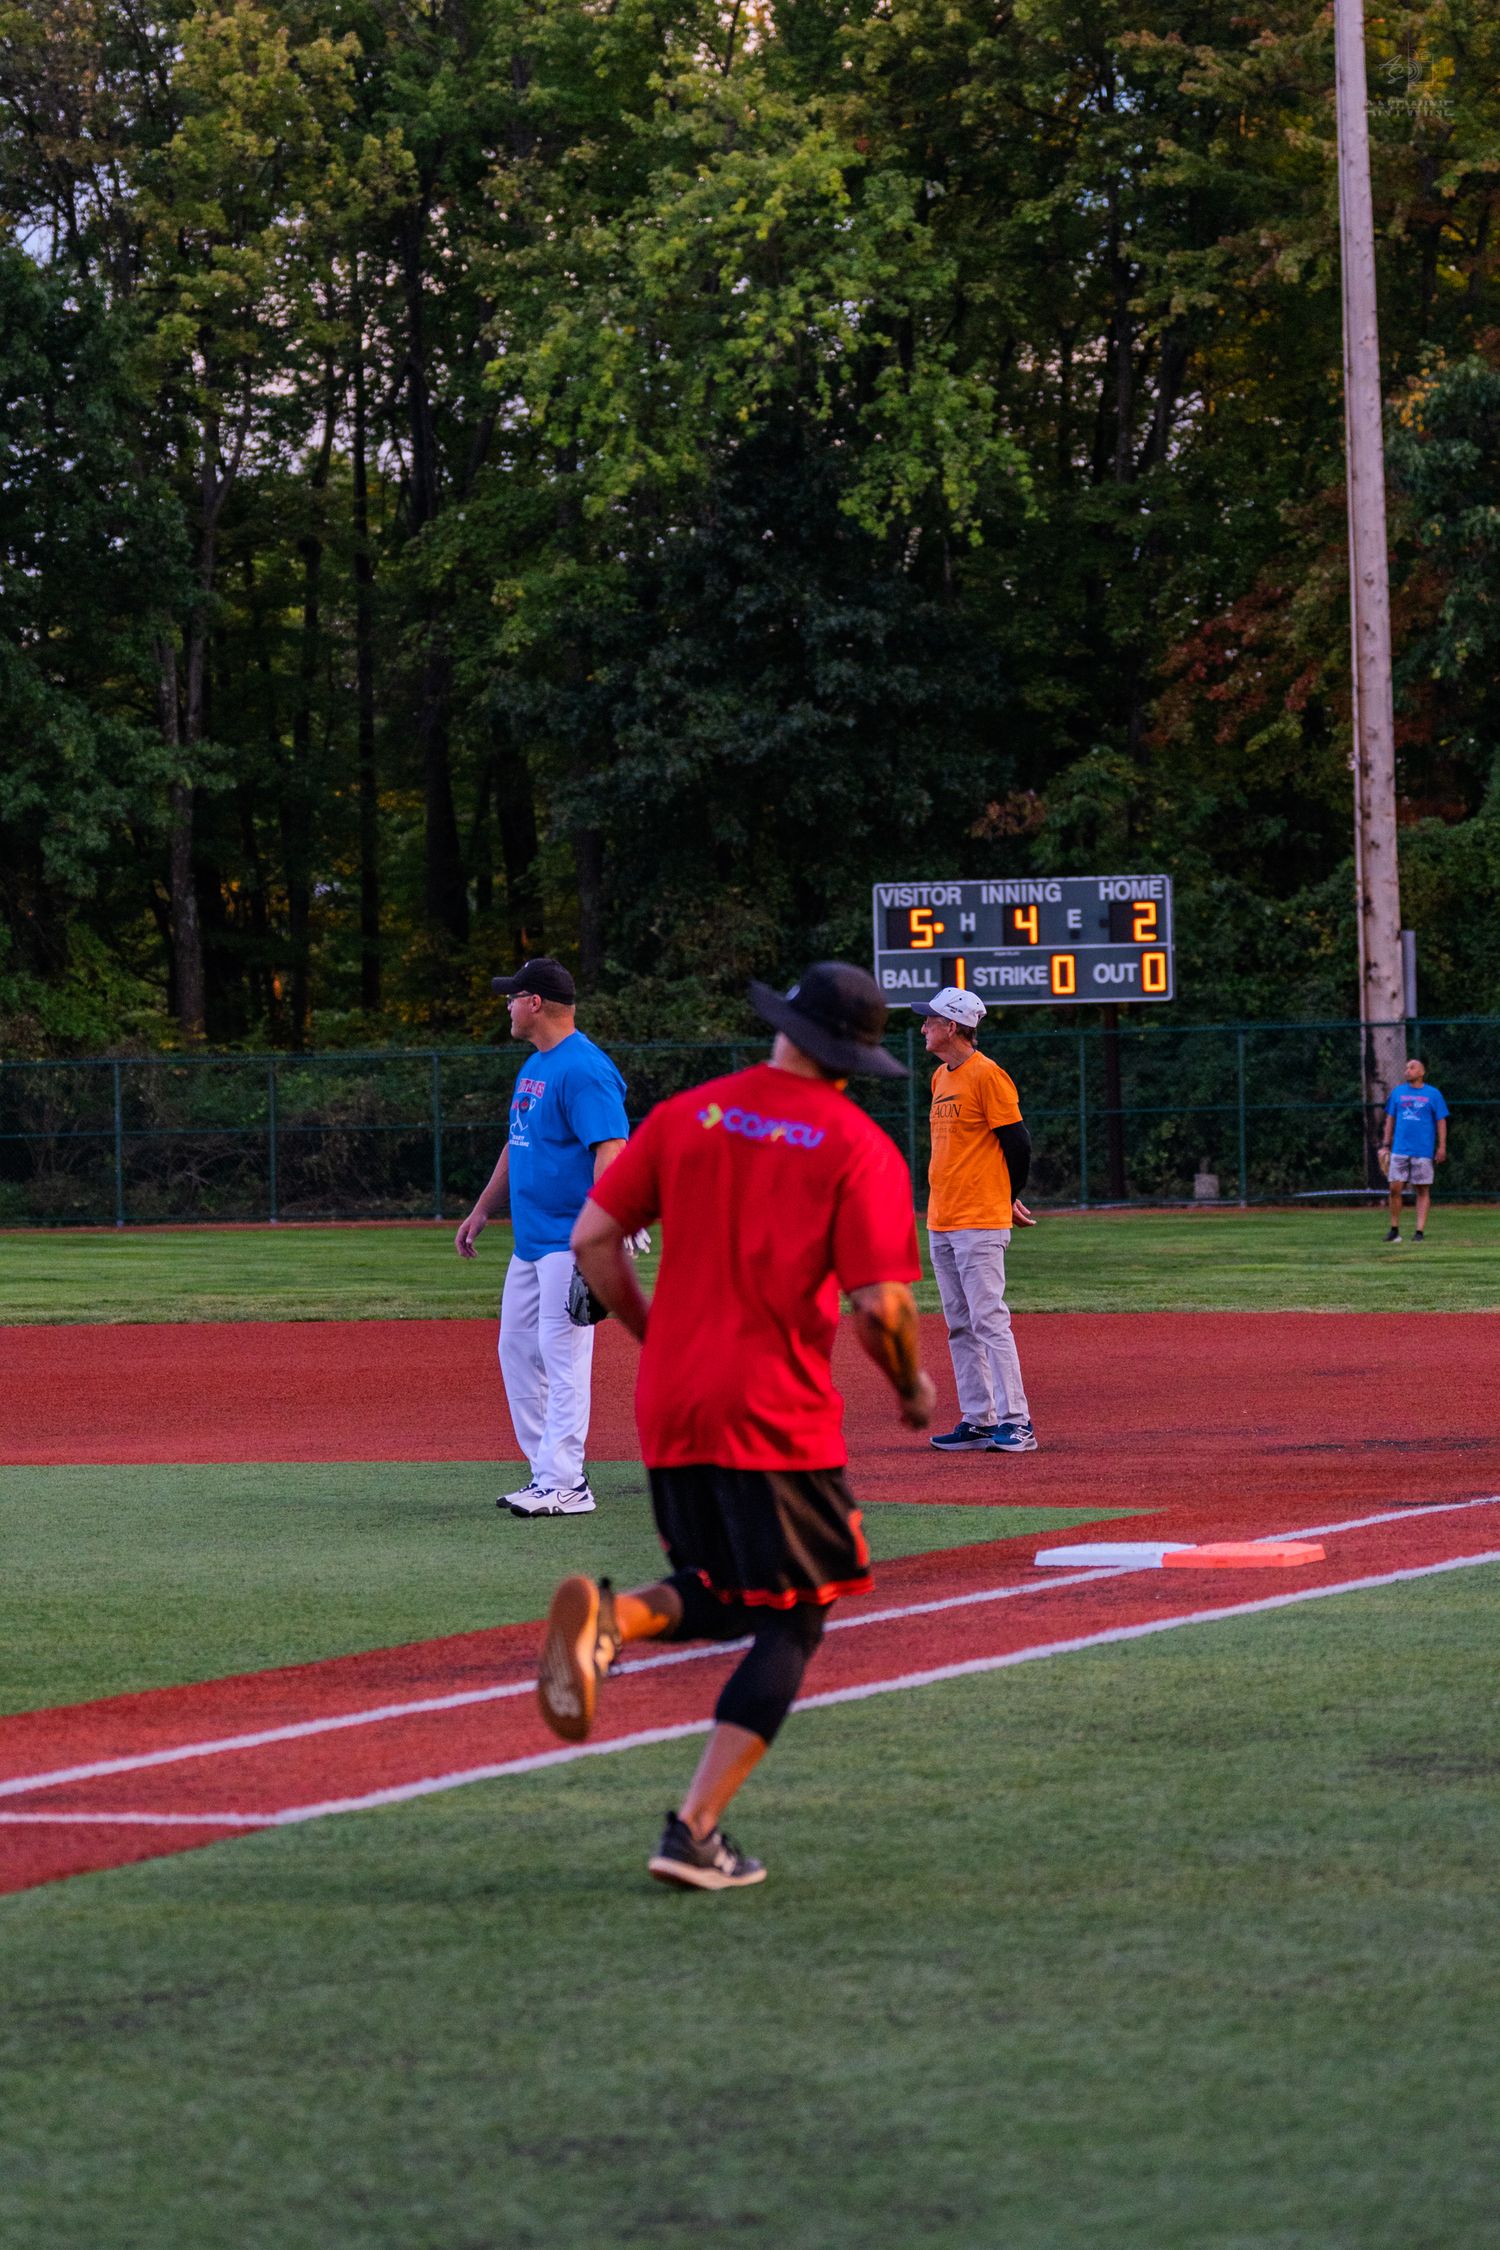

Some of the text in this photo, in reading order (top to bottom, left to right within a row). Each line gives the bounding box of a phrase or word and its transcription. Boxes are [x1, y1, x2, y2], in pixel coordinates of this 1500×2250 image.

[880, 880, 1163, 907] VISITOR INNING HOME
[910, 902, 1157, 949] 5 H 4 E 2
[882, 952, 1167, 994] BALL 1 STRIKE 0 OUT 0
